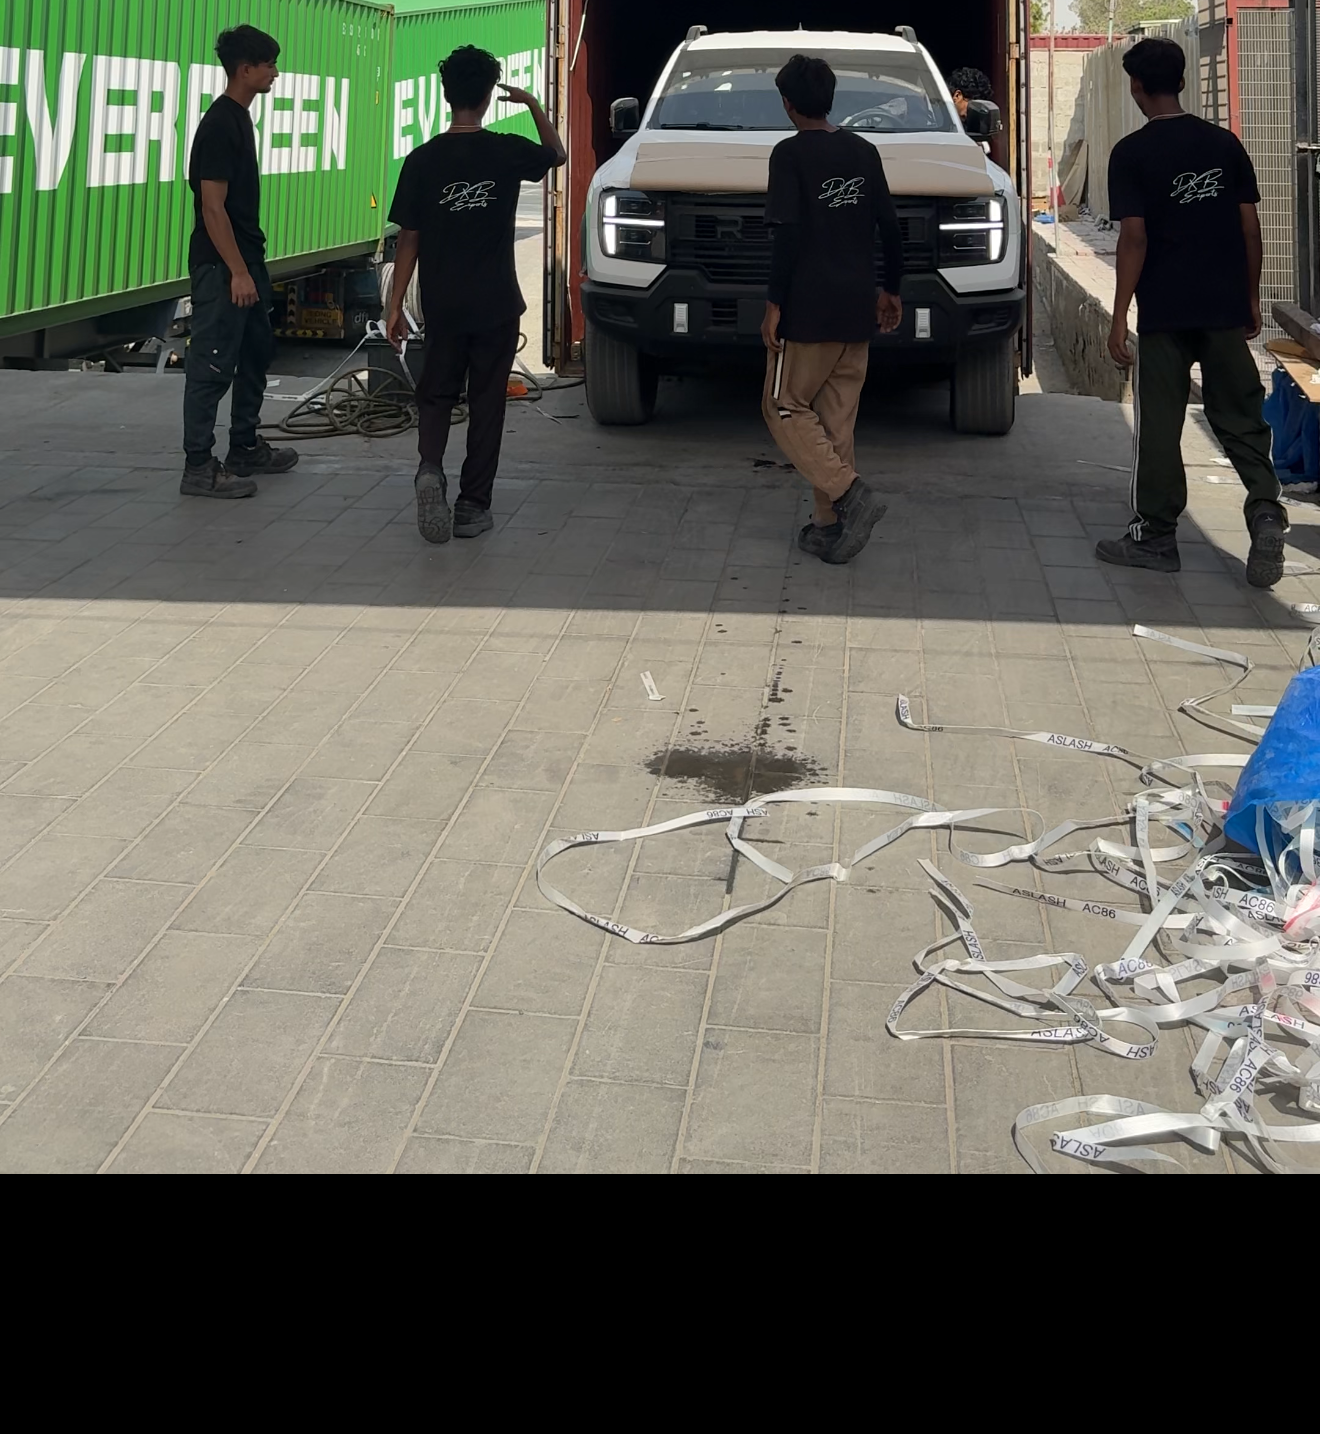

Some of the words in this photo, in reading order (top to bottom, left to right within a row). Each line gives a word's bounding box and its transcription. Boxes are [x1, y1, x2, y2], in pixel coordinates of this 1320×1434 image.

[393, 47, 546, 160] EVREEN
[0, 46, 350, 194] VEREEN
[1047, 734, 1092, 751] ASLASH
[1130, 876, 1161, 897] AC6
[1012, 888, 1067, 908] ASLASH
[1082, 903, 1116, 919] AC86
[1239, 895, 1275, 913] AC86
[1304, 972, 1320, 984] 86
[1074, 1014, 1110, 1042] AC86
[1229, 1059, 1258, 1093] AC86
